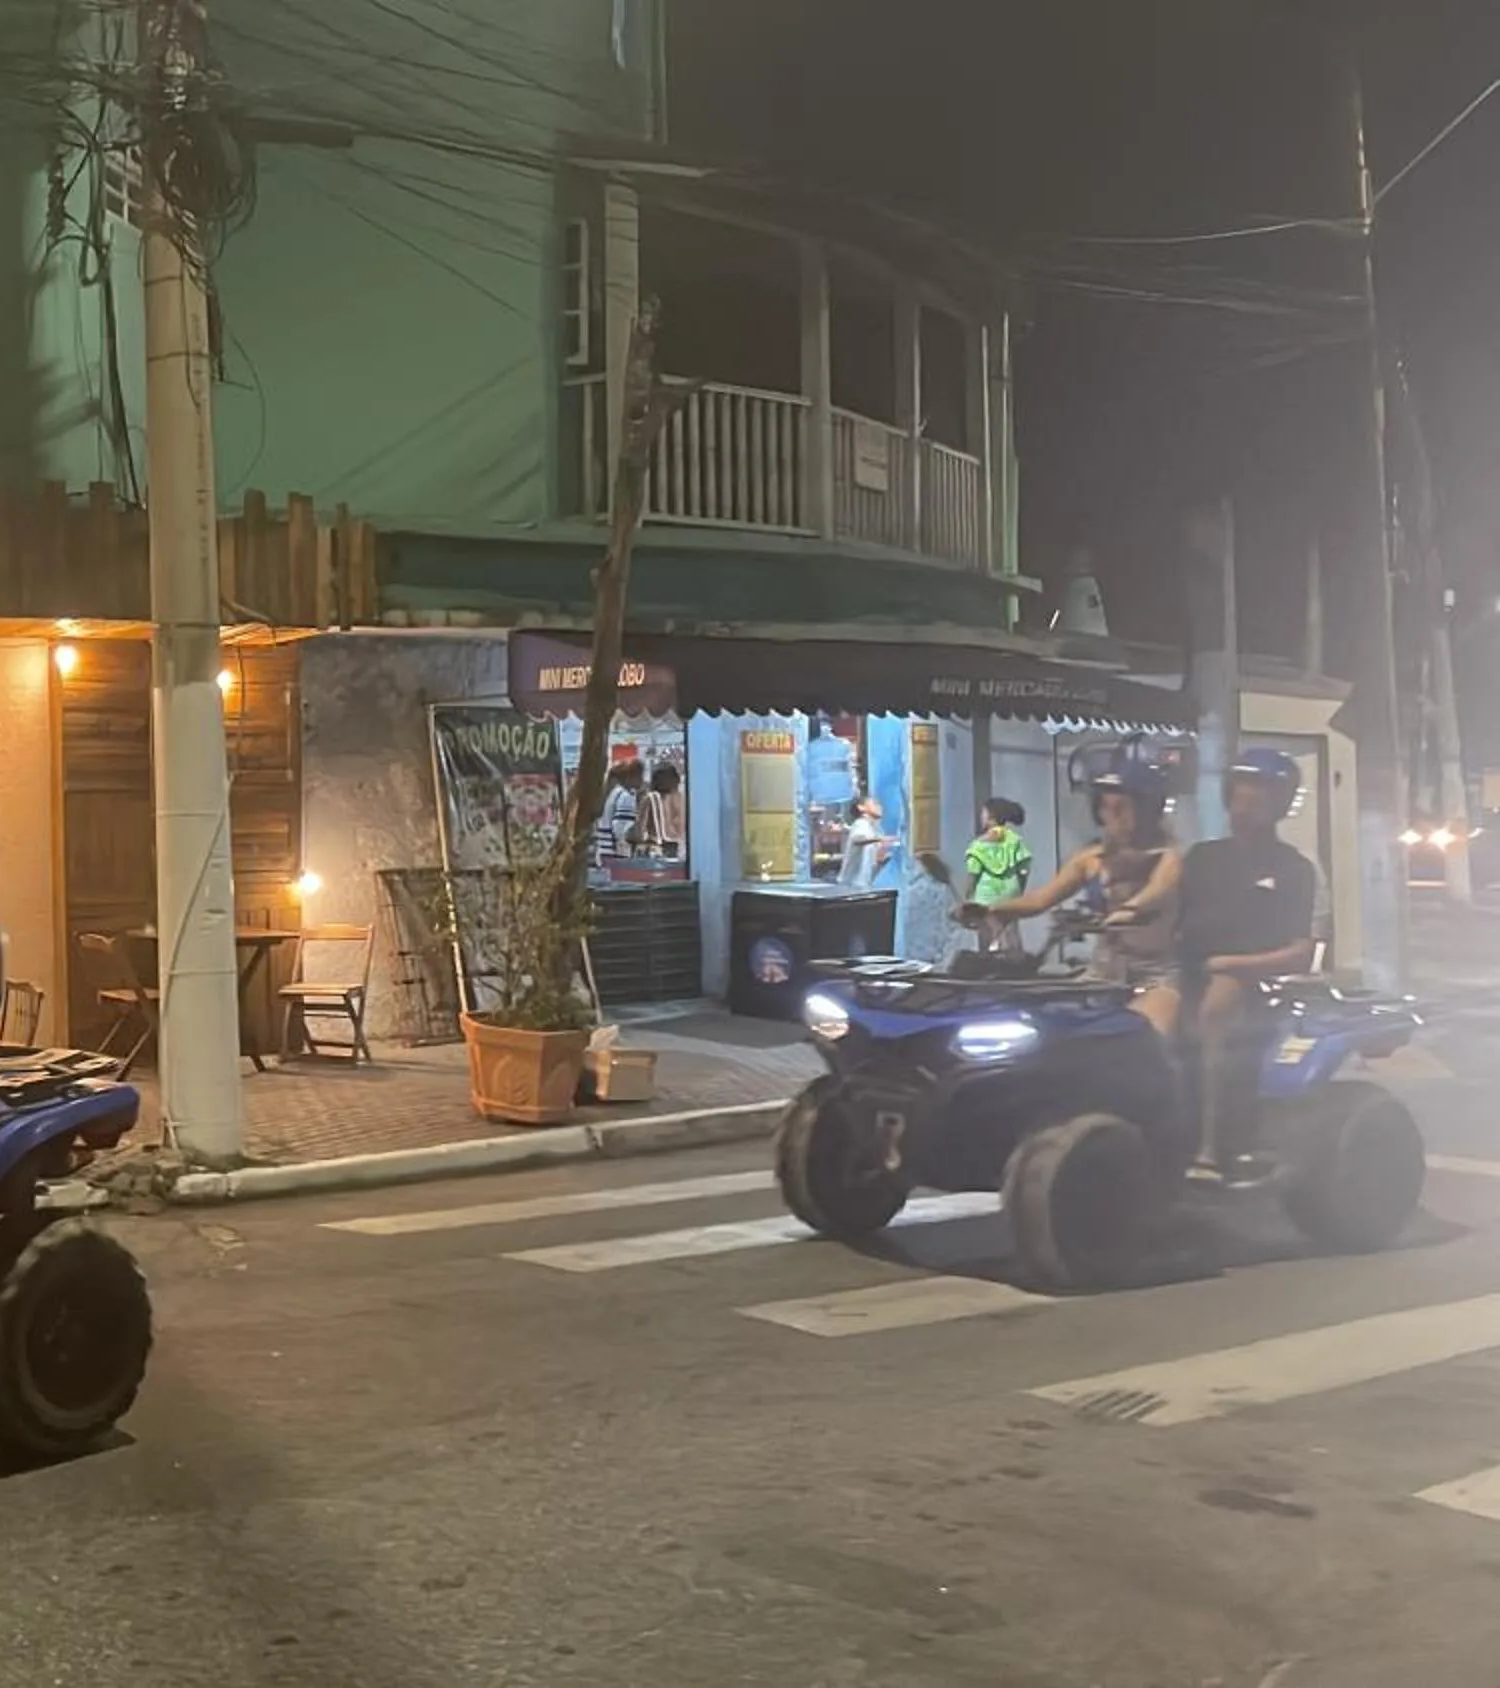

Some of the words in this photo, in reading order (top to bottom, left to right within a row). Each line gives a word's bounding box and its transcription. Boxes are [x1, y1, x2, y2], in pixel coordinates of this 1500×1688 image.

[539, 667, 561, 690] MINI
[930, 677, 970, 695] MINI
[746, 731, 791, 750] OFERTA
